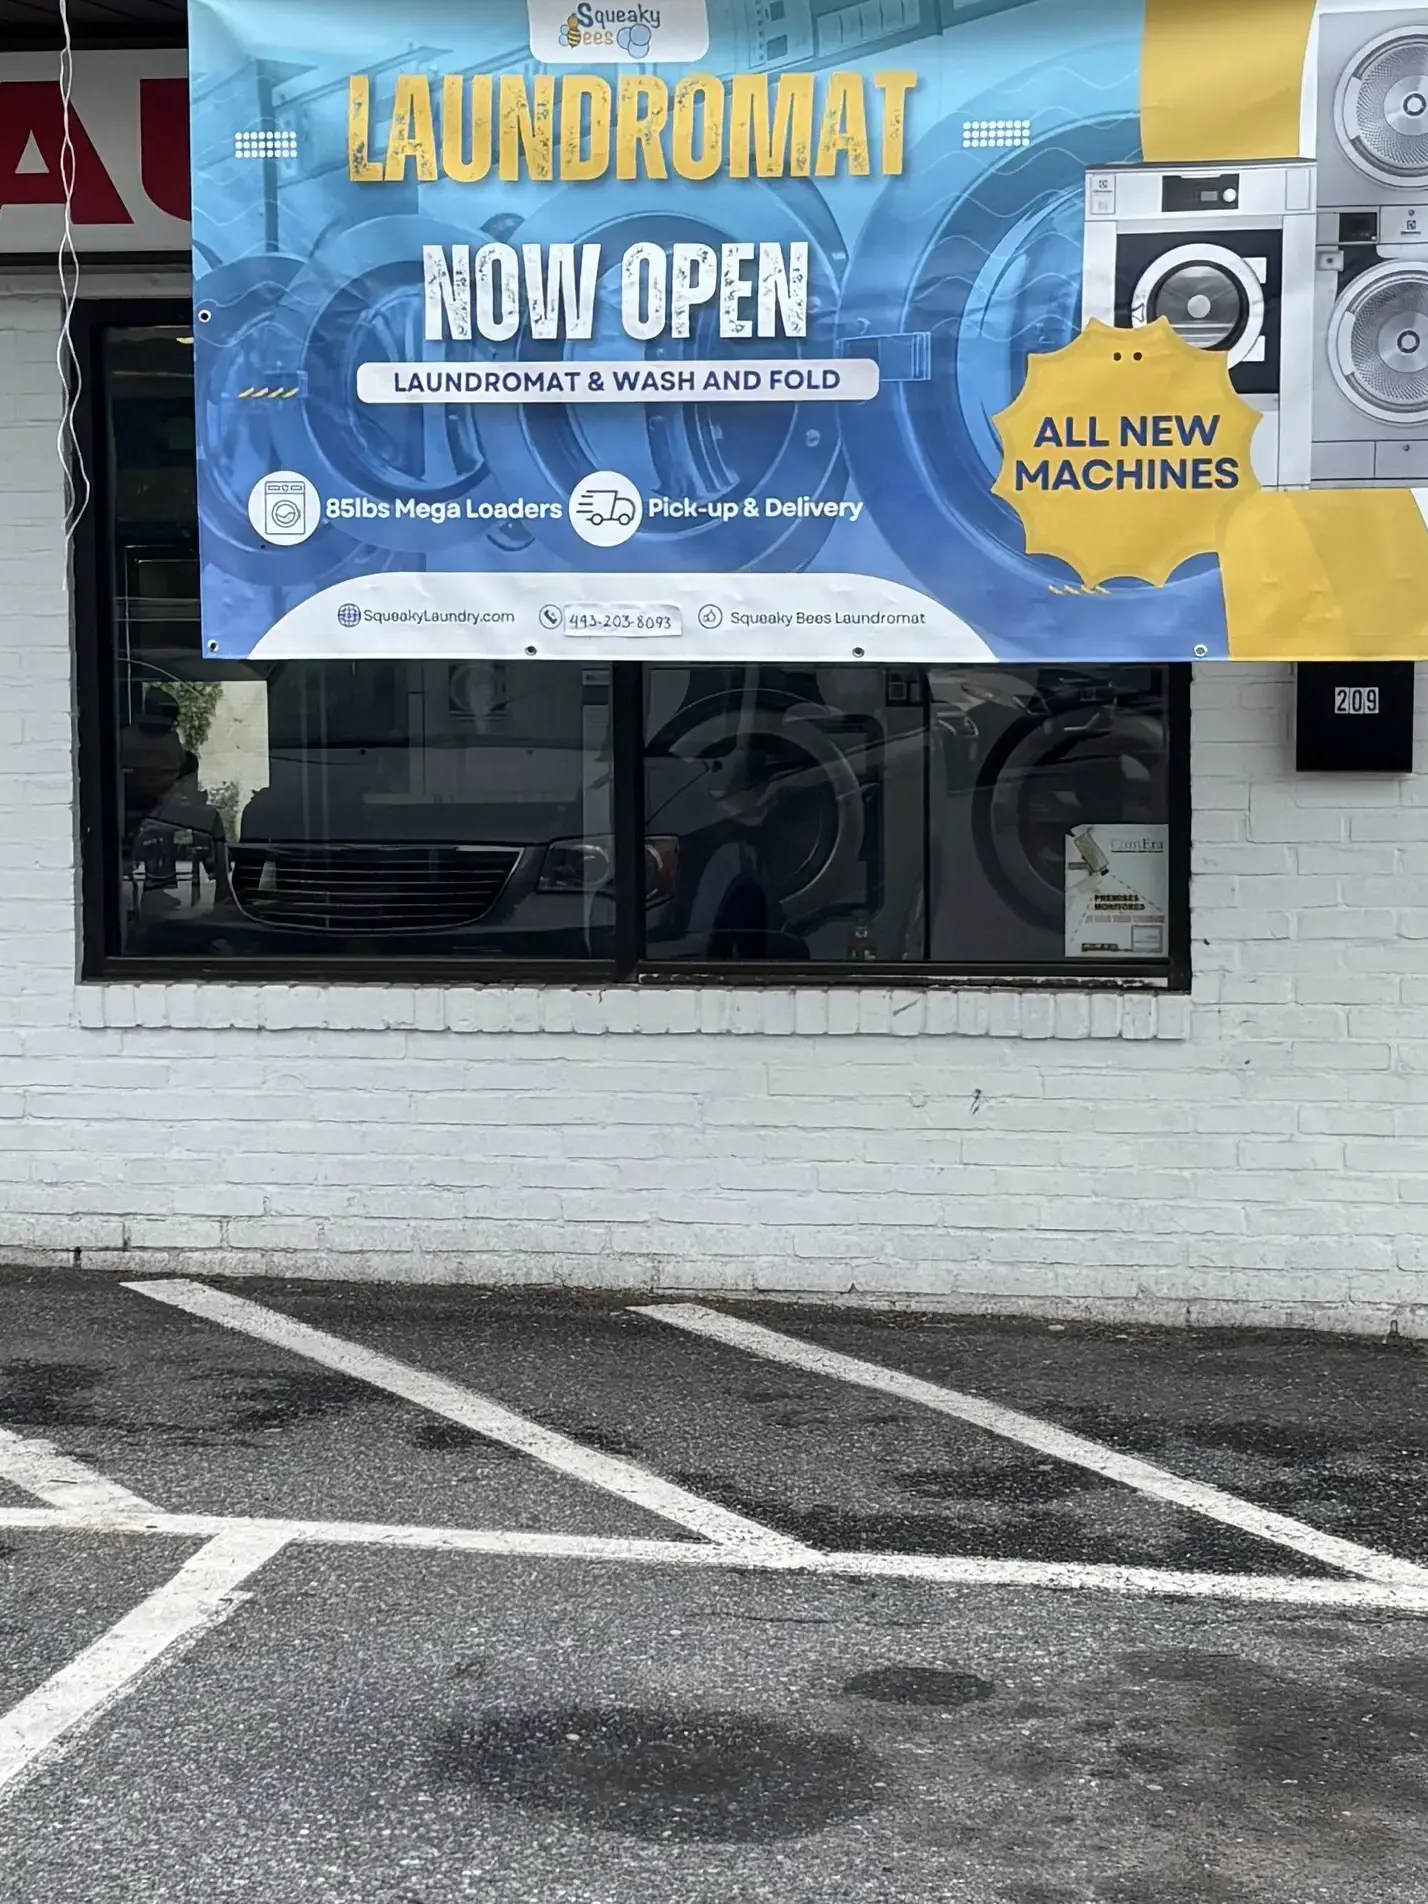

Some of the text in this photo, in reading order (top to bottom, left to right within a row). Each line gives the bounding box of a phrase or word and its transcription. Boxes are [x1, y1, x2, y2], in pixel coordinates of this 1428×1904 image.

[577, 2, 661, 29] Squeaky
[346, 72, 917, 183] LAUNDROMAT
[422, 241, 809, 341] NOW OPEN
[393, 369, 841, 394] LAUNDROMAT & WASH AND FOLD
[1033, 414, 1221, 448] ALL NEW
[1015, 456, 1240, 491] MACHINES
[324, 498, 563, 524] 85lbs Mega Loaders
[648, 497, 864, 523] Pick-up & Delivery
[364, 609, 515, 625] SqueakyLaundry.com
[730, 611, 926, 627] Squeaky Bees Laundromat
[1337, 689, 1376, 712] 209
